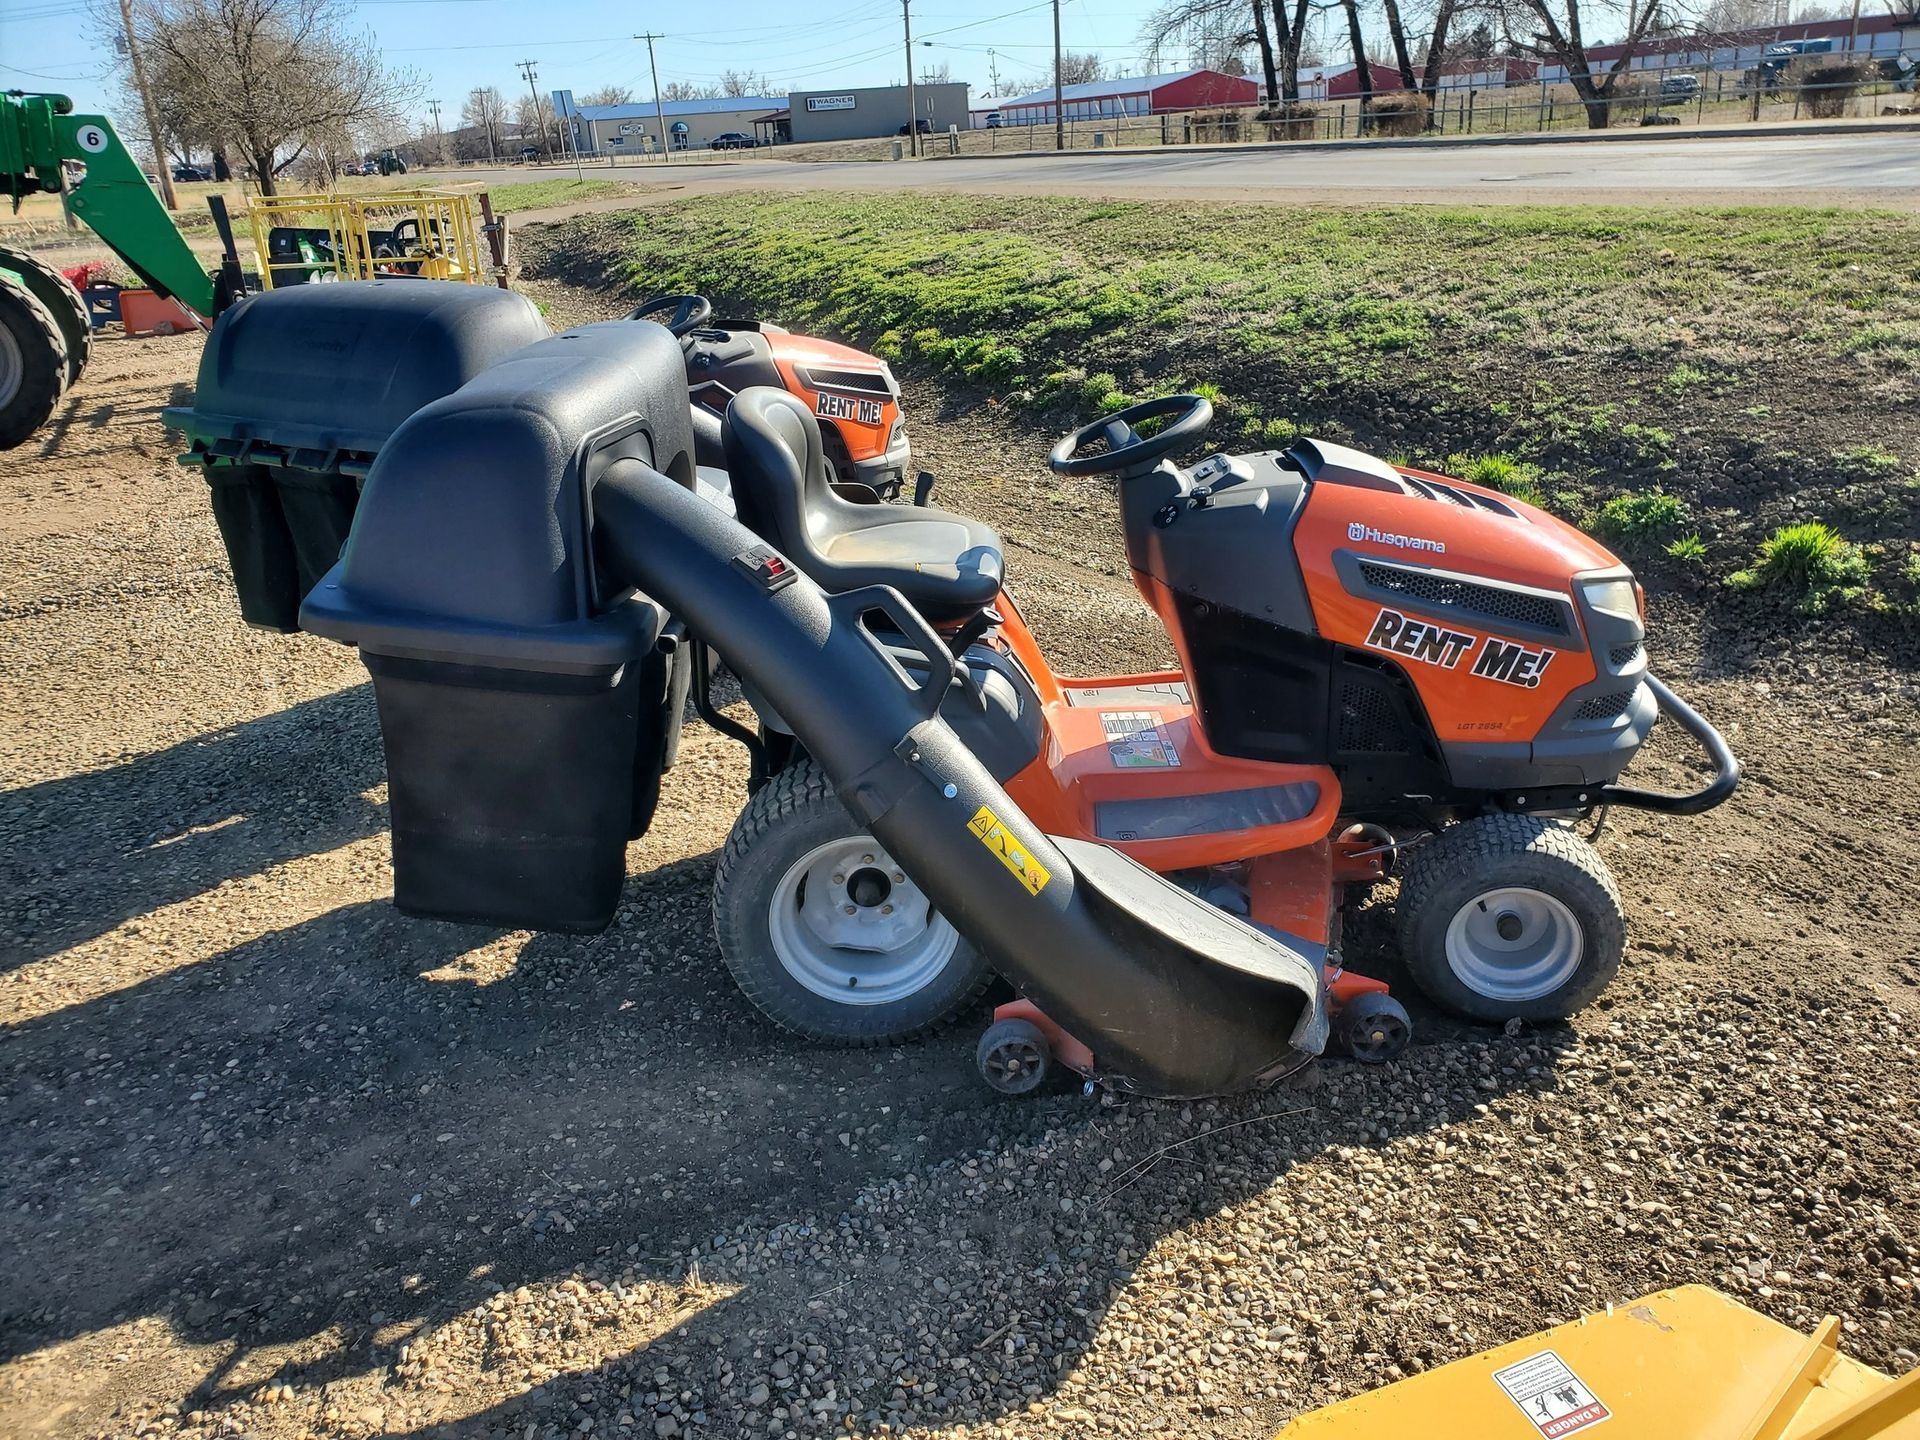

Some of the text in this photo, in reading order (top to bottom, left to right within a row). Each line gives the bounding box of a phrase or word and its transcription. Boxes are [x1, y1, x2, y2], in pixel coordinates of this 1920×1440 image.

[816, 96, 854, 104] WAGNER
[87, 132, 99, 146] 6
[816, 392, 883, 425] RENT ME!
[1365, 527, 1446, 554] Husqvarna
[1365, 609, 1555, 688] RENT ME!
[1546, 1411, 1593, 1435] DANGER
